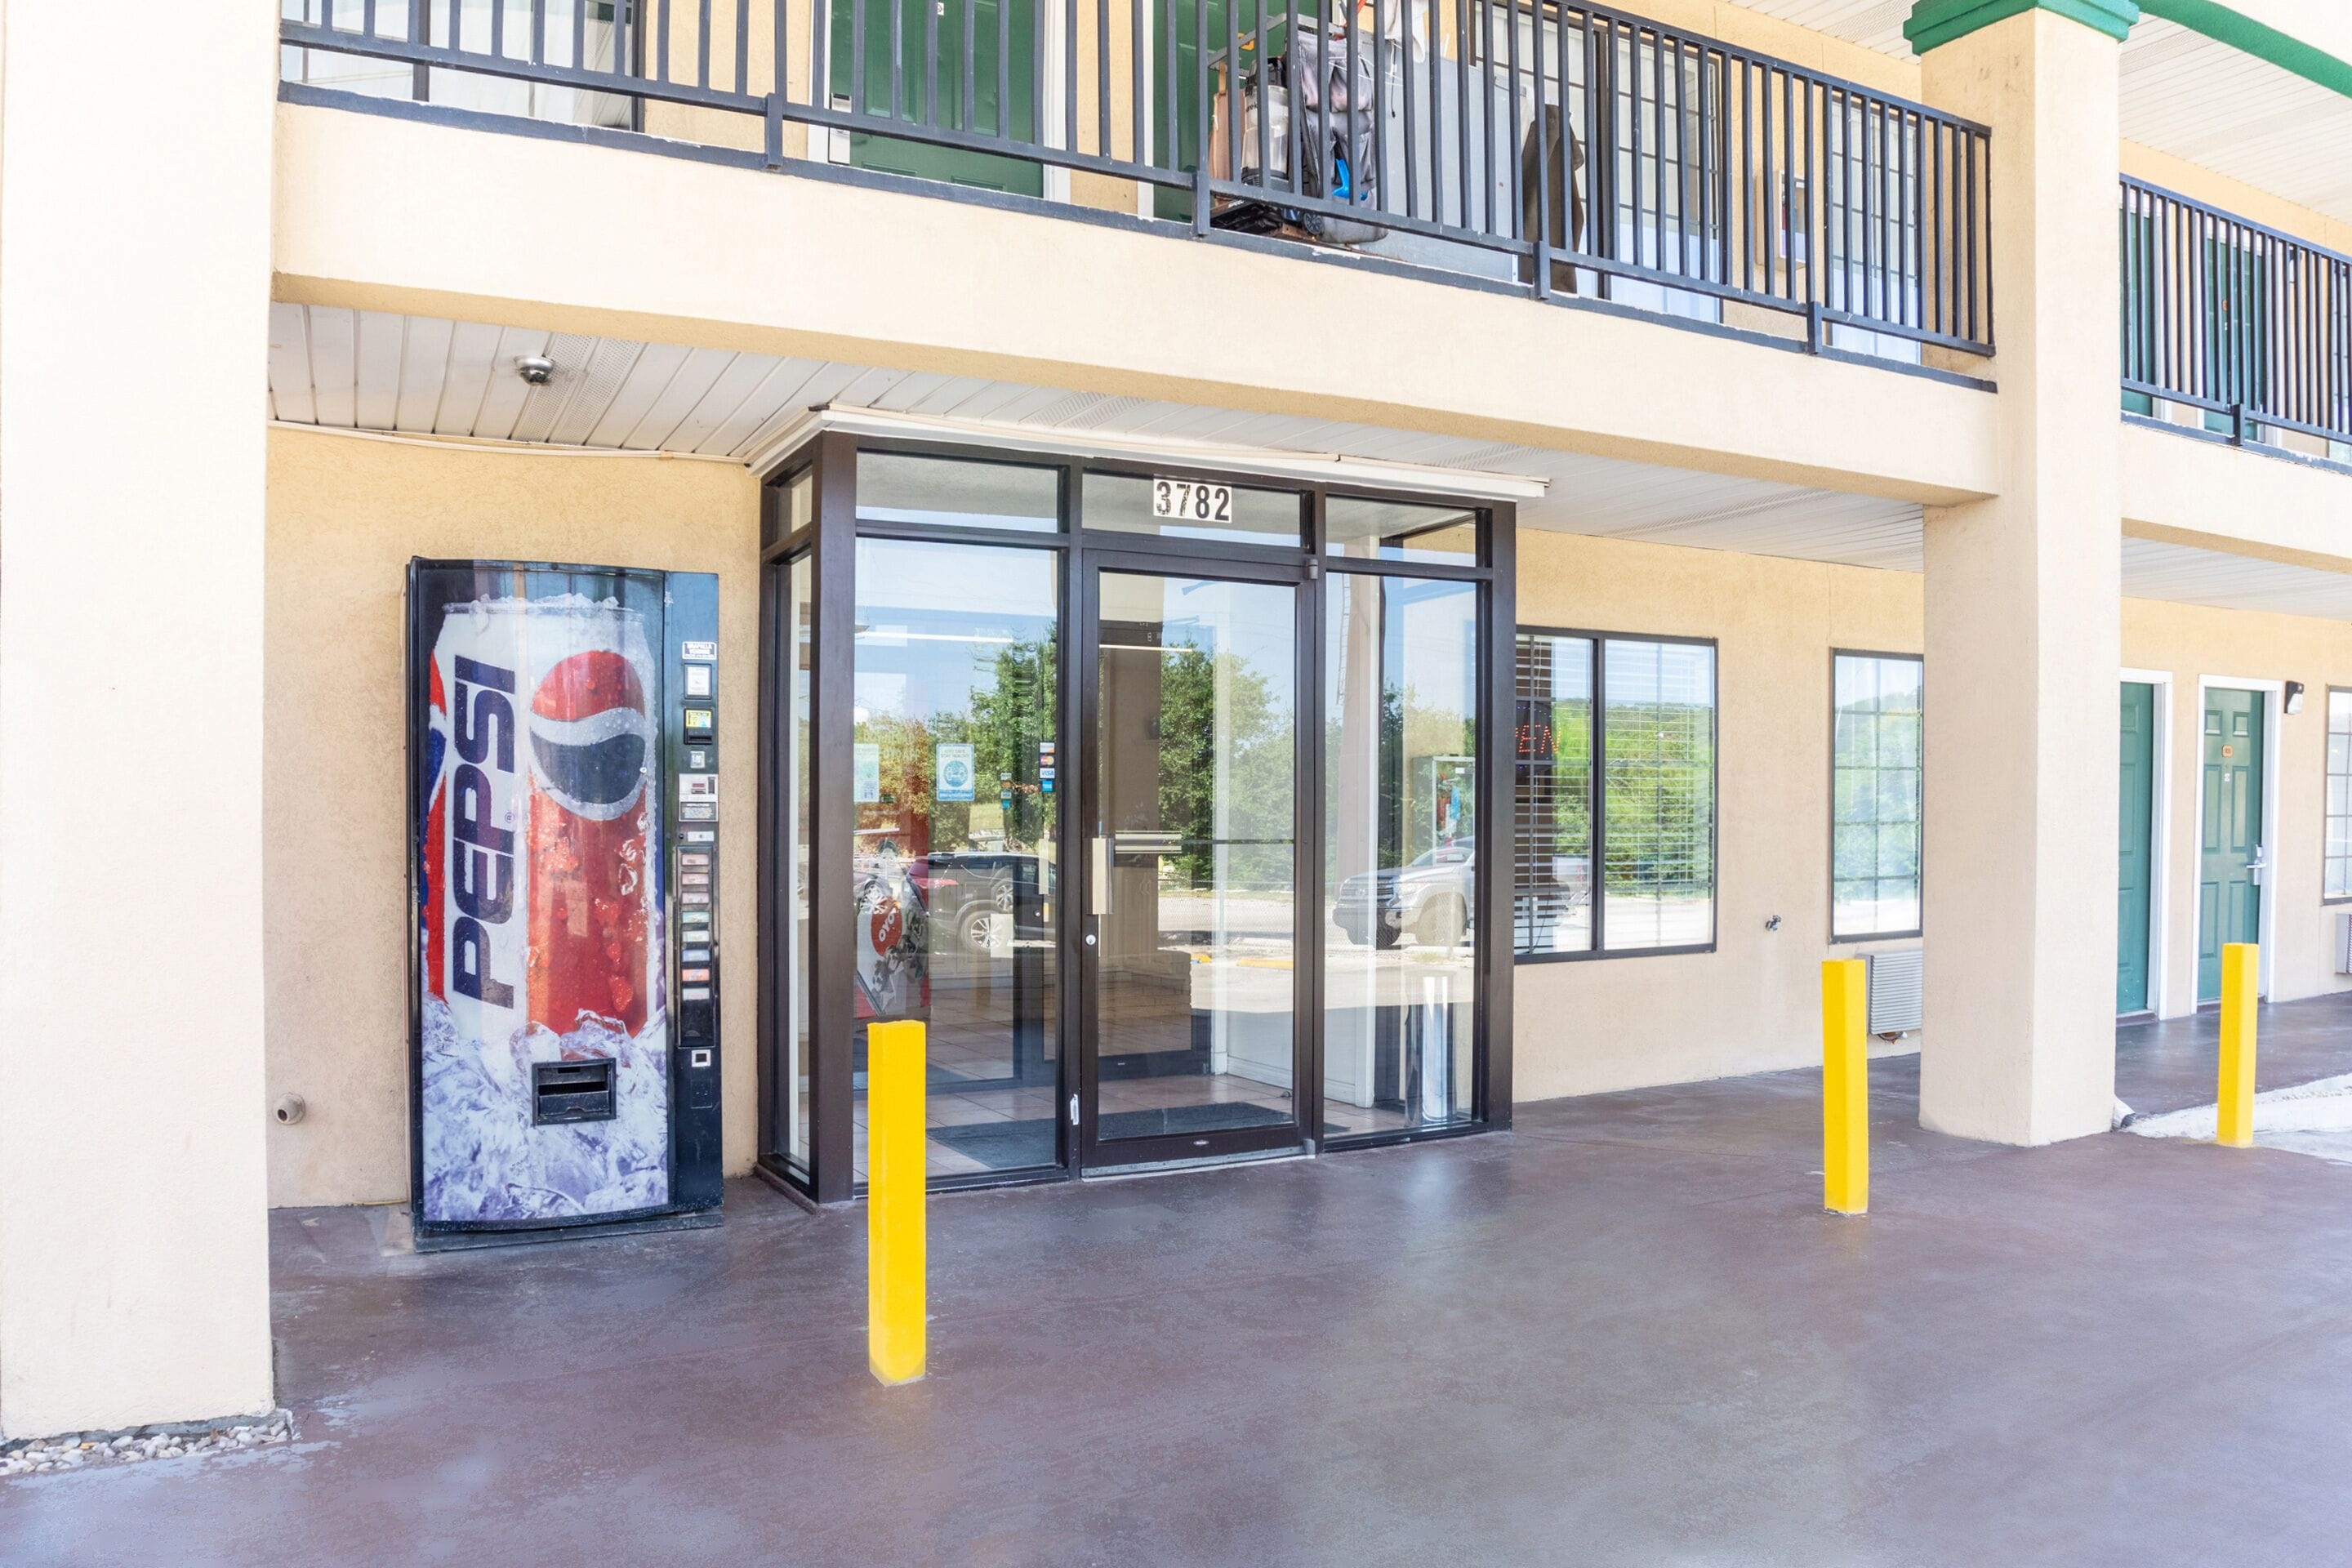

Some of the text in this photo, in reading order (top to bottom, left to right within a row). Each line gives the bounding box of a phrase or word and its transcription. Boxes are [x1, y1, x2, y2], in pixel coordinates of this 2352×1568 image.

[1156, 481, 1230, 521] 3782
[452, 654, 516, 1009] PEPSI
[878, 912, 895, 942] OYO
